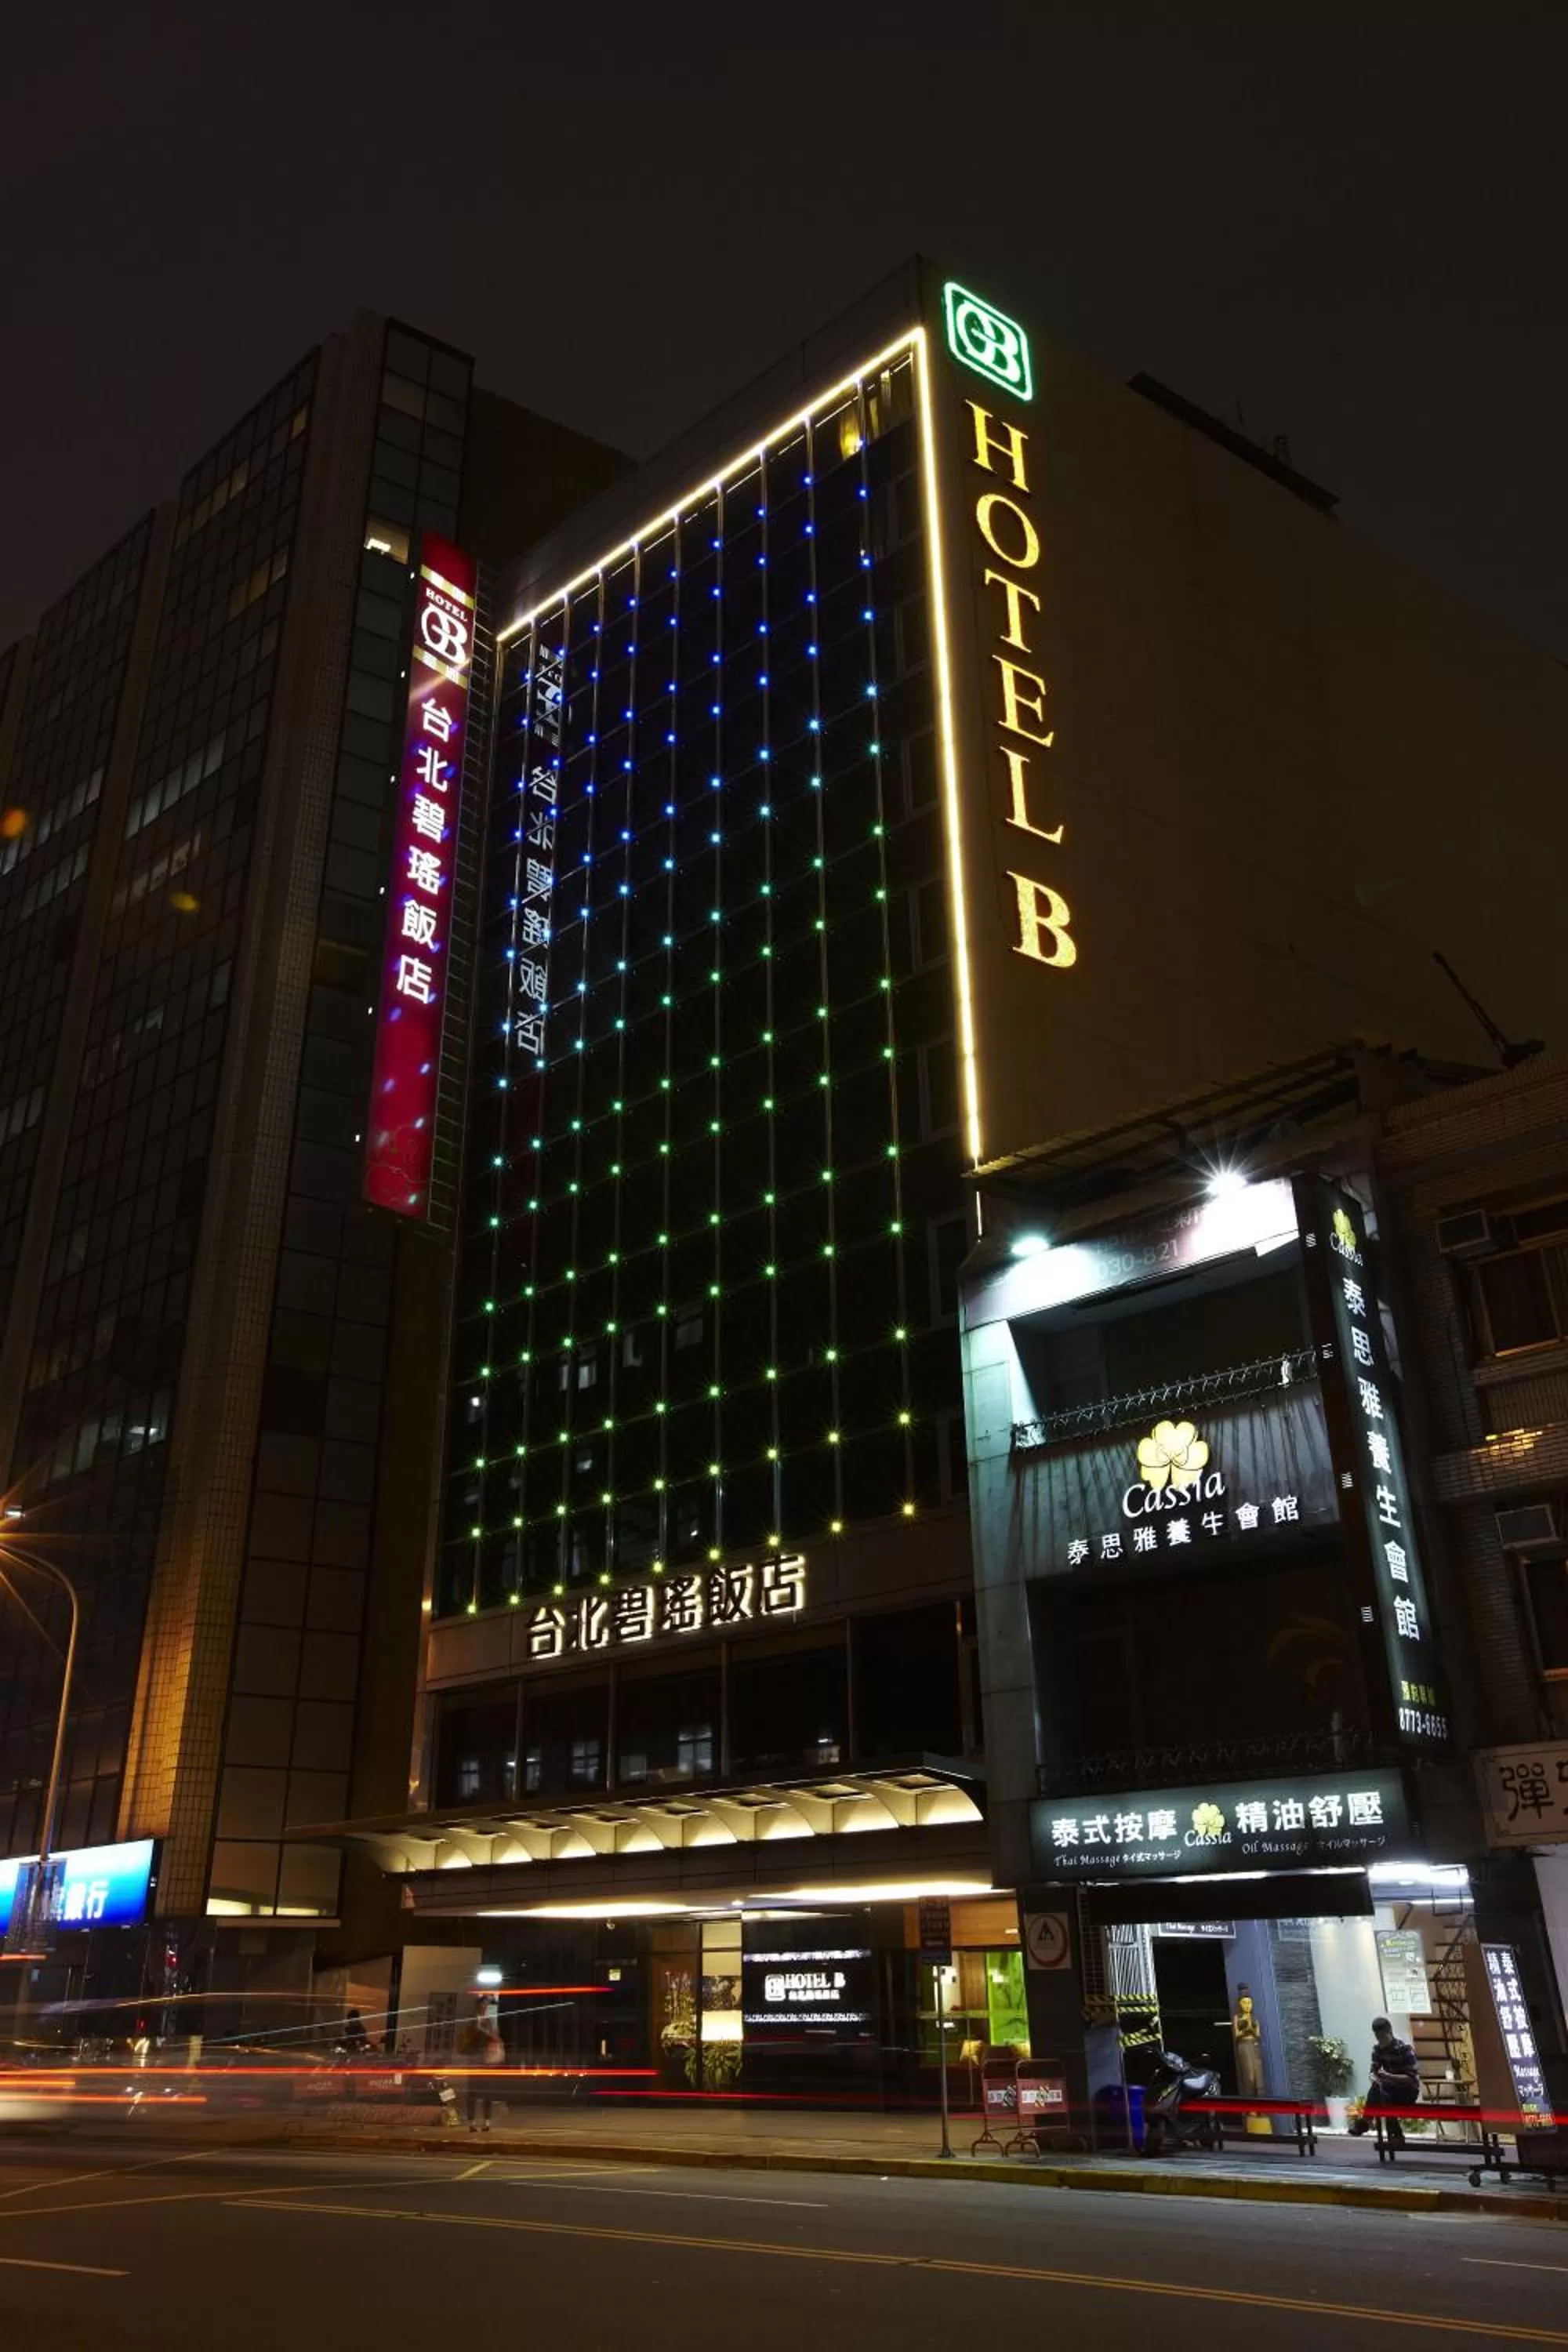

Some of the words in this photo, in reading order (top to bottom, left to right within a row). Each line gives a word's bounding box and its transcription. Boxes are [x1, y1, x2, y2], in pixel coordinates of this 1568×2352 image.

[426, 587, 468, 622] HOTEL
[965, 398, 1064, 844] HOTEL
[397, 696, 454, 1005] 台北碧瑤飯店
[1006, 870, 1078, 969] B
[1341, 1277, 1421, 1642] 泰思雅養生會館
[1122, 1470, 1226, 1519] Cassia
[1051, 1809, 1178, 1849] 泰式按摩
[1235, 1791, 1385, 1835] 精油舒壓
[1185, 1828, 1232, 1849] Cassia
[1053, 1853, 1078, 1867] Thai
[1079, 1853, 1120, 1869] Massage
[784, 1972, 831, 1989] HOTEL
[833, 1971, 846, 1988] B
